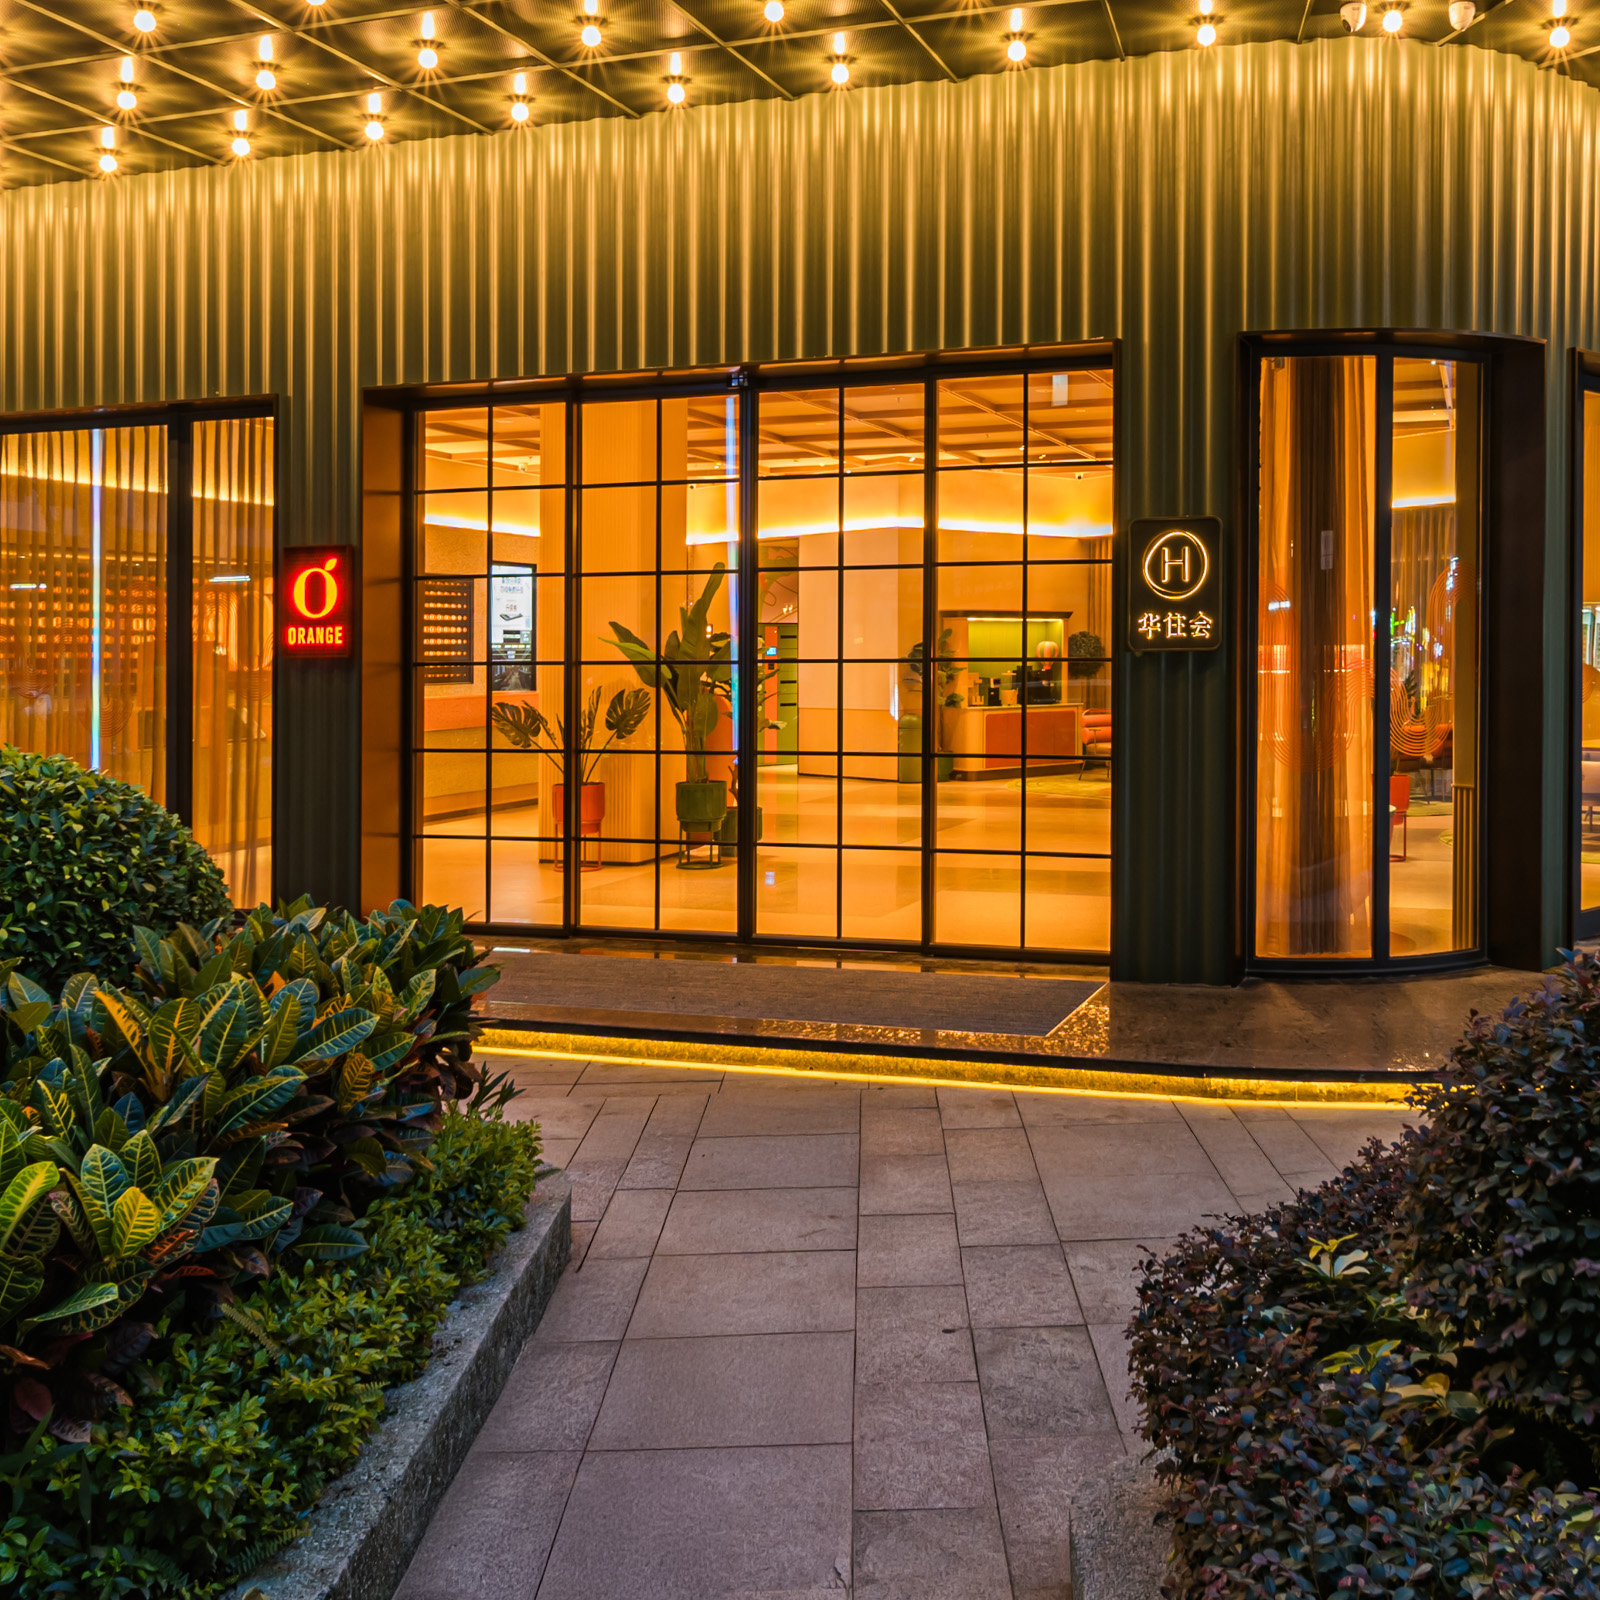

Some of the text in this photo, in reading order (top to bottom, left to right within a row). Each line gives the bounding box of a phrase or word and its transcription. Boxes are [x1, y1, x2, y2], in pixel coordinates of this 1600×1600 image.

[1161, 546, 1190, 583] H
[287, 626, 343, 645] ORANGE
[1137, 611, 1214, 640] 华住会
